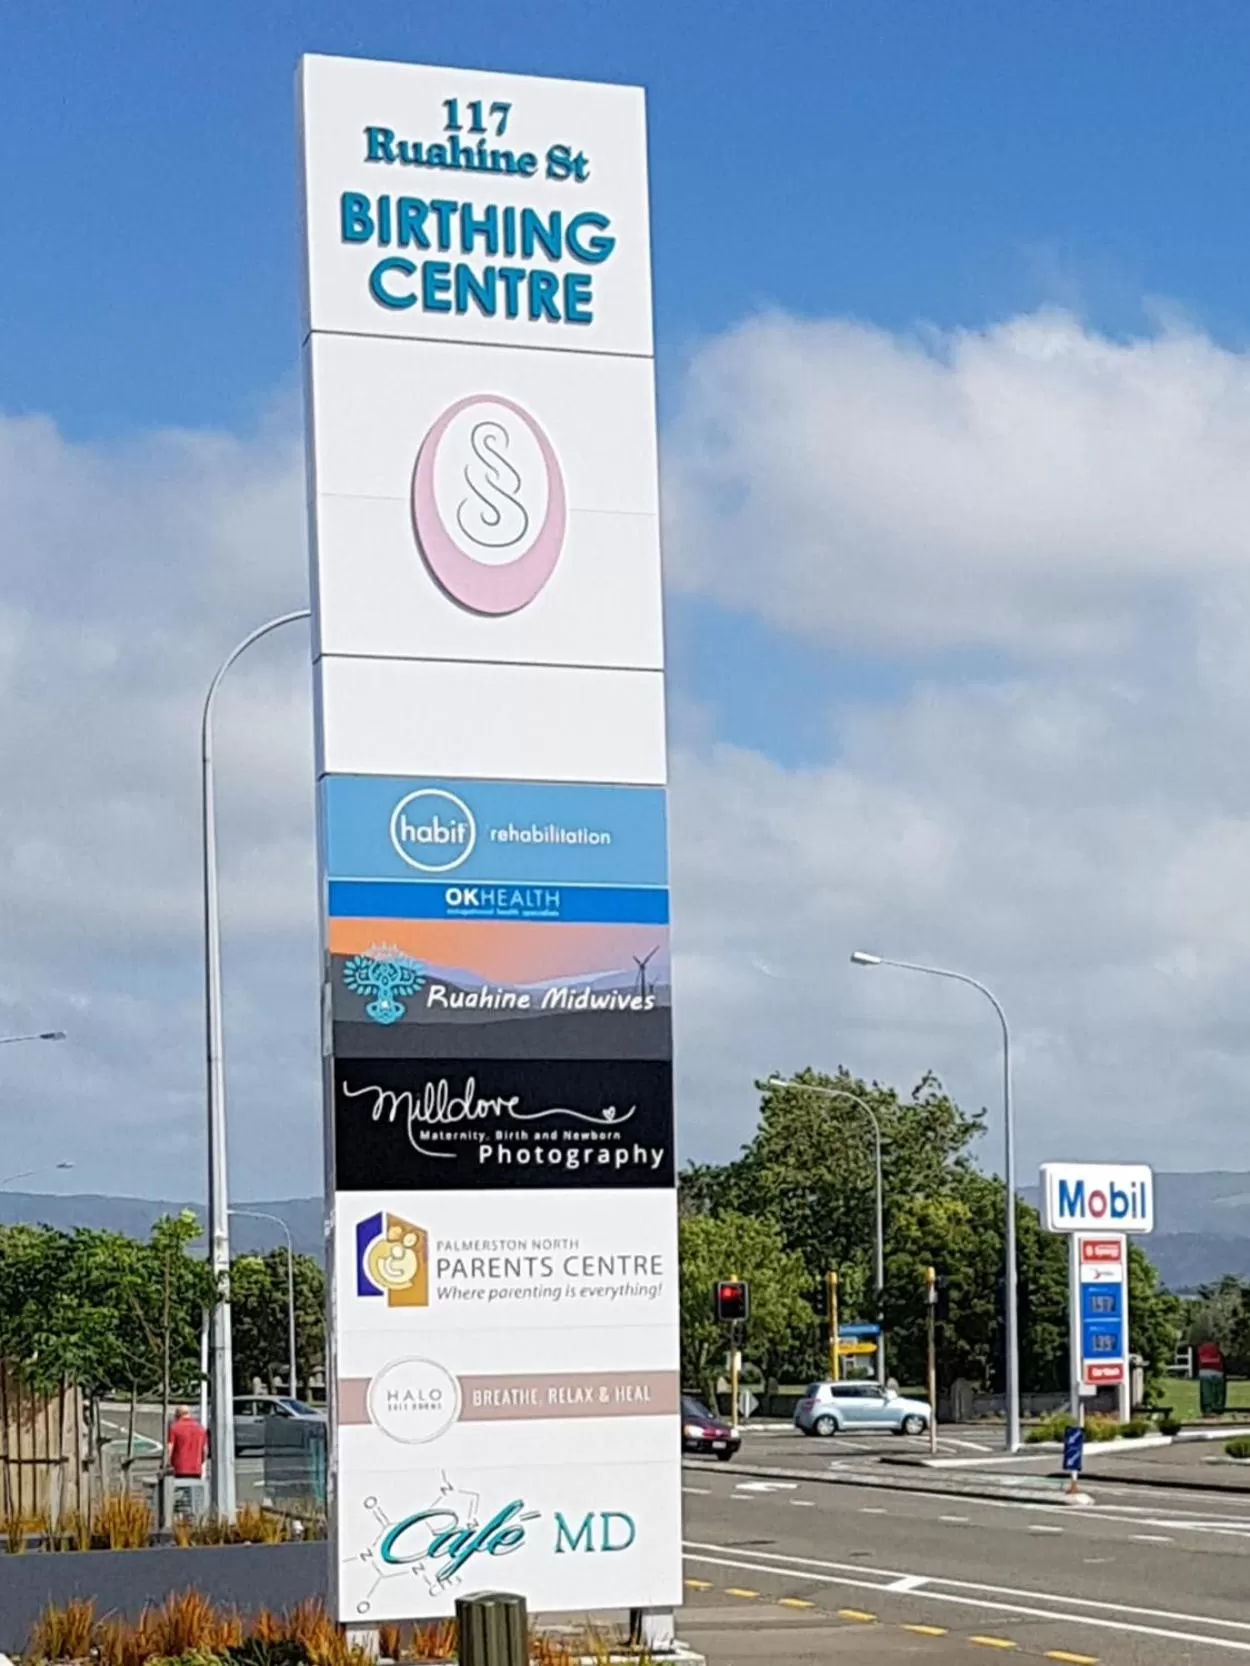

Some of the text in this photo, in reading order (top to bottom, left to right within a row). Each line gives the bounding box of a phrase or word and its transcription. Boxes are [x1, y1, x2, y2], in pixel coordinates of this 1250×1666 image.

[442, 97, 512, 136] 117
[363, 126, 591, 183] Ruahine St
[340, 191, 616, 265] BIRTHING
[369, 256, 594, 325] CENTRE
[401, 815, 611, 845] habit rehabilitation
[426, 985, 656, 1011] Ruahine Midwives
[495, 1130, 528, 1140] Birth
[534, 1130, 558, 1140] and
[563, 1130, 621, 1140] Newborn
[479, 1143, 665, 1169] Photography
[1058, 1179, 1146, 1219] Mobil
[436, 1238, 579, 1252] PALMERSTON NORTH
[437, 1254, 663, 1279] PARENTS CENTRE
[437, 1282, 663, 1302] Where parenting is everything!
[387, 1388, 442, 1401] HALO
[548, 1386, 593, 1404] RELAX
[599, 1386, 609, 1403] &
[615, 1385, 650, 1401] HEAL
[554, 1511, 636, 1554] MD
